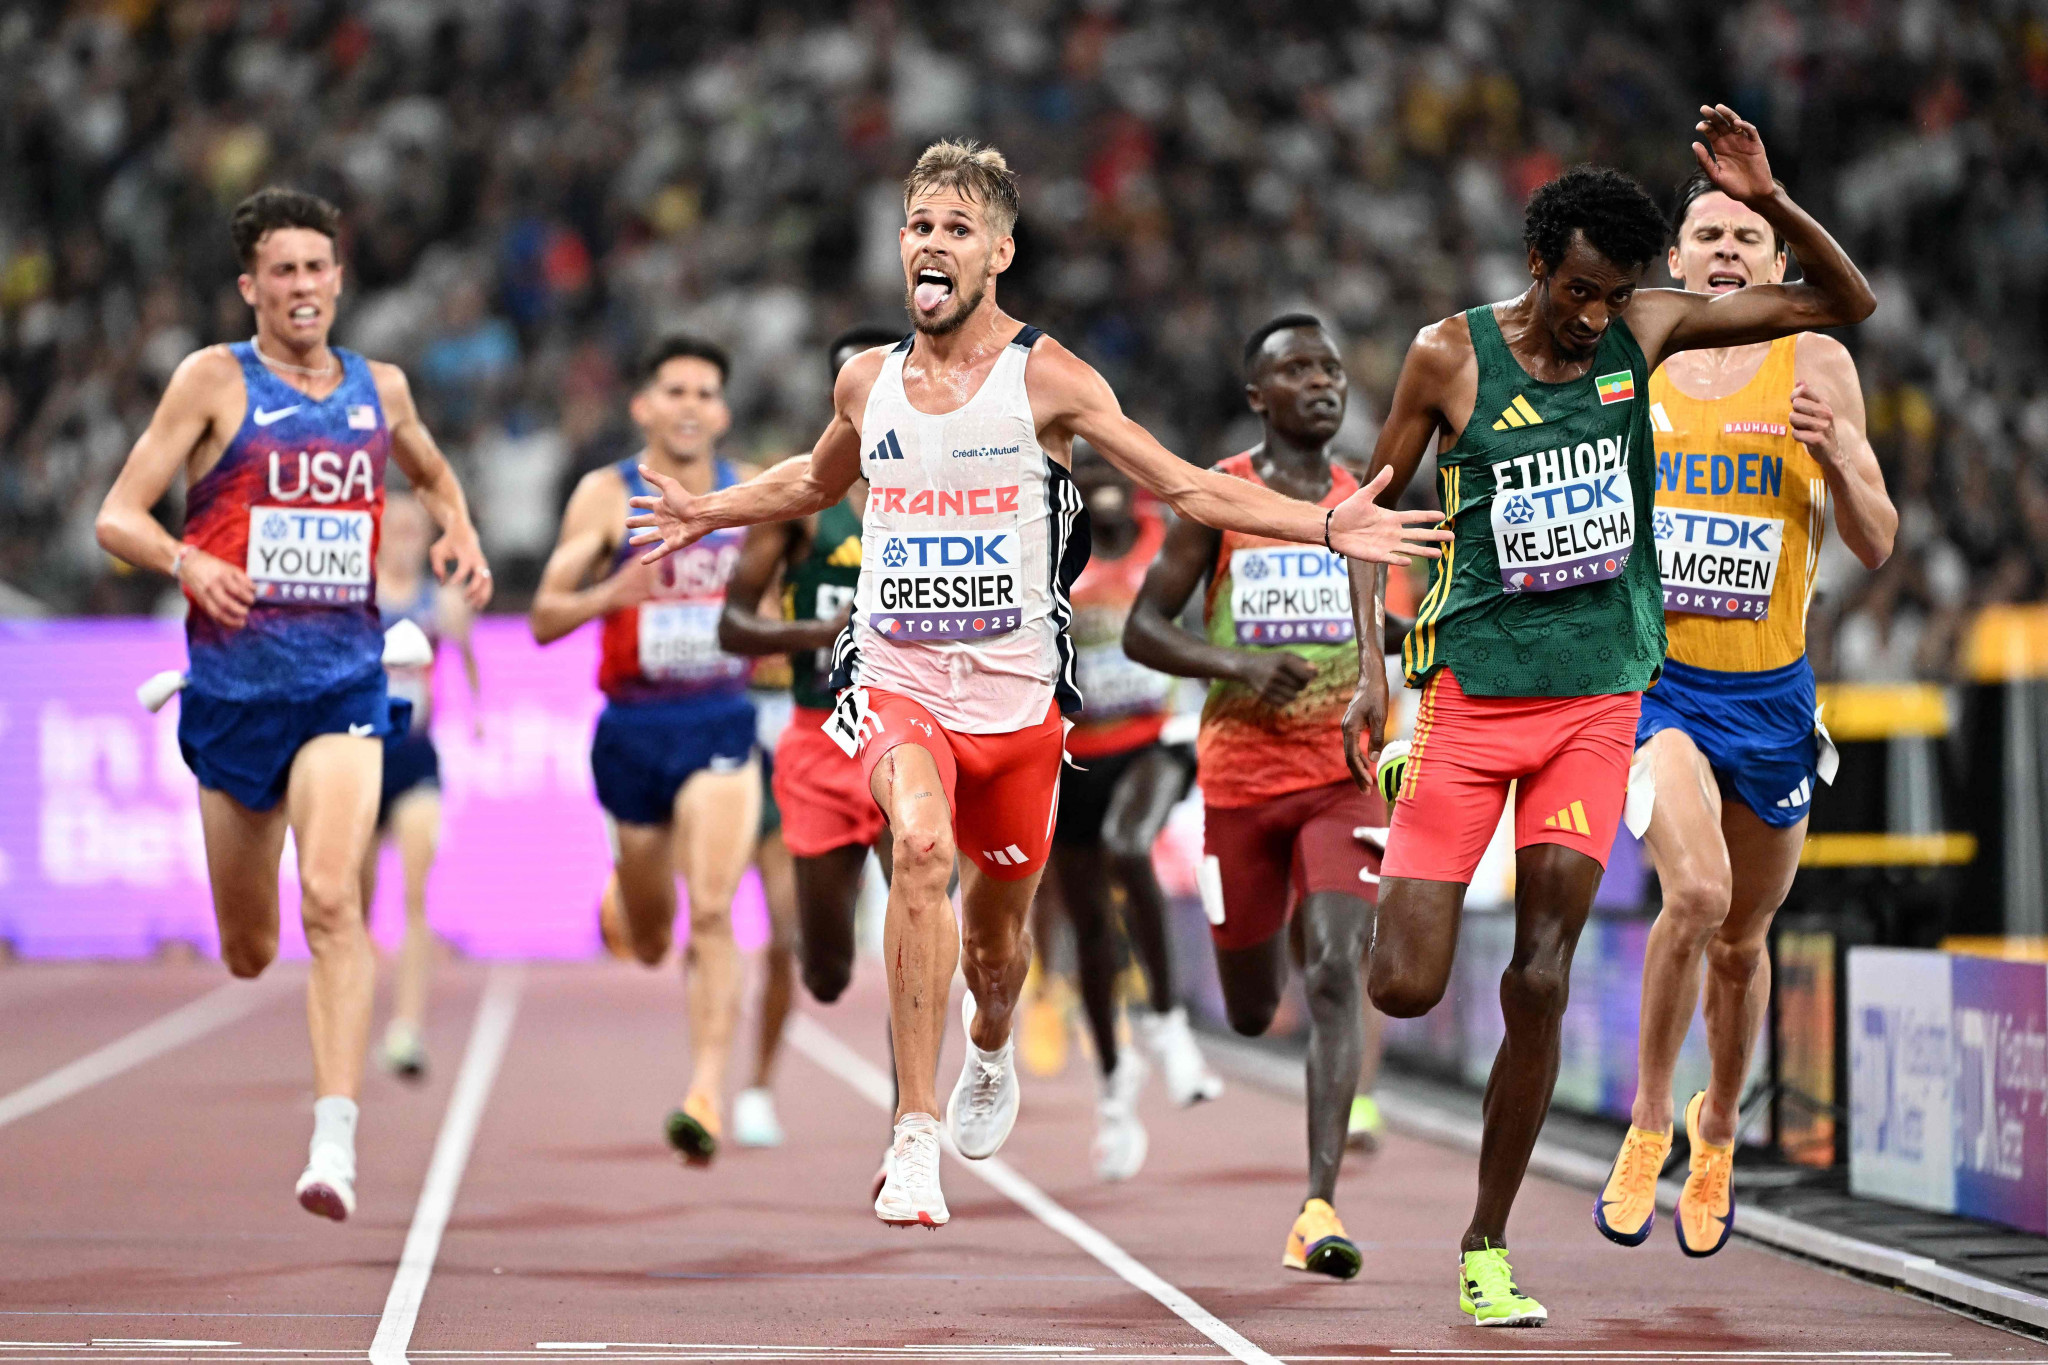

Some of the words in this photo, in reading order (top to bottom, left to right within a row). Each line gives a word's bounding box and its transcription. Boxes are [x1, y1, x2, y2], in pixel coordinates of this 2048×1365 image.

[1725, 423, 1786, 436] BAUHAUS
[952, 448, 978, 458] Crédit
[989, 445, 1020, 456] Mutuel
[268, 450, 375, 504] USA
[1654, 451, 1783, 498] WEDEN
[870, 485, 1020, 516] FRANCE
[1531, 474, 1625, 519] TDK
[290, 515, 363, 542] TDK
[1502, 511, 1632, 563] KEJELCHA
[1675, 513, 1772, 552] TDK
[259, 547, 362, 577] YOUNG
[907, 534, 1010, 567] TDK
[1268, 553, 1348, 577] TDK
[1657, 549, 1771, 590] LMGREN
[880, 574, 1014, 610] GRESSIER
